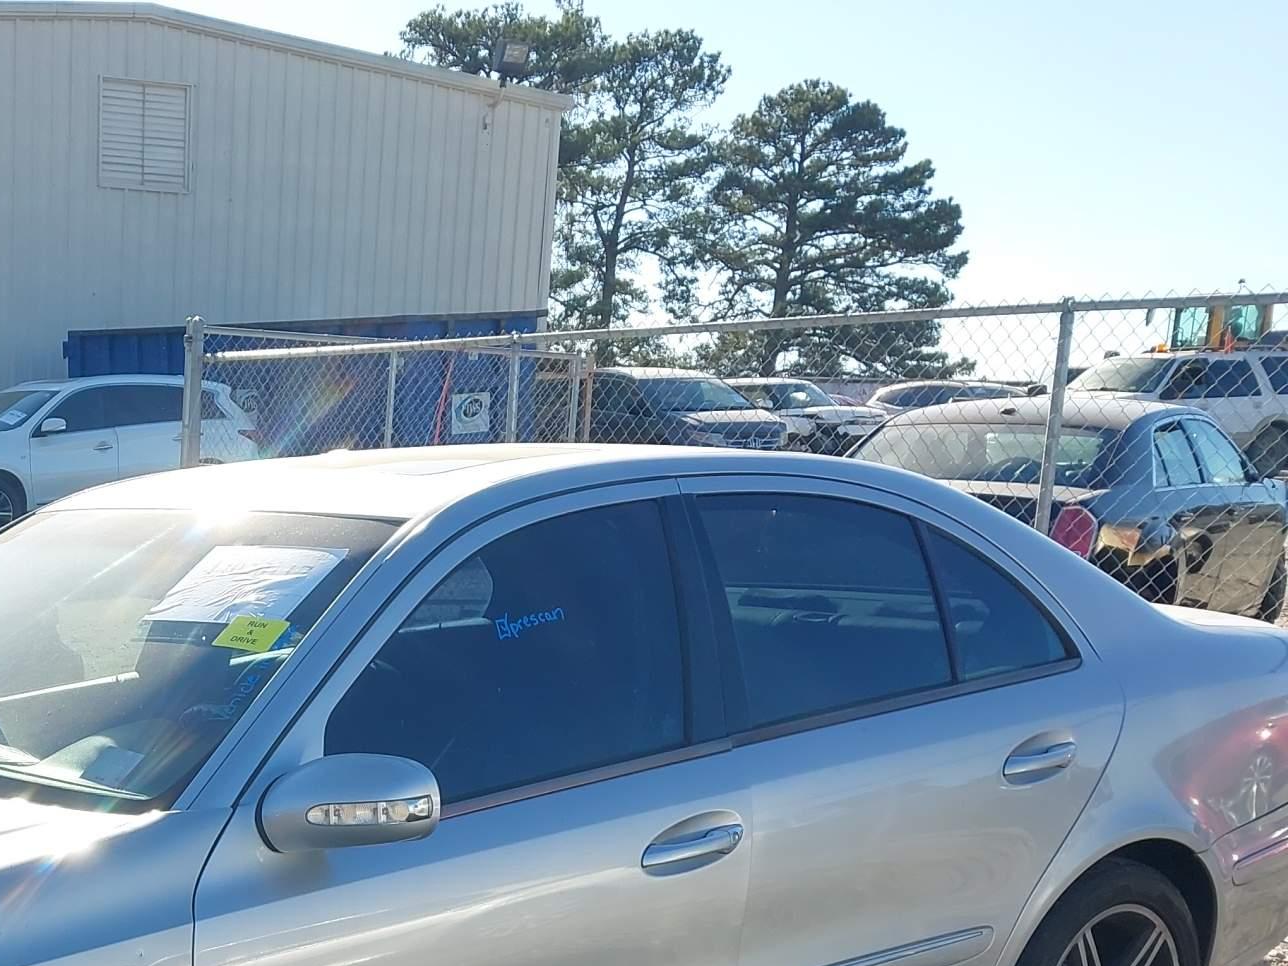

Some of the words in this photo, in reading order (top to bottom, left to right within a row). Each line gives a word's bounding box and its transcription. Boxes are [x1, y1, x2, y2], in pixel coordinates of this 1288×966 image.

[247, 620, 269, 629] RUN
[509, 607, 565, 639] prescan
[230, 635, 257, 645] DRIVE
